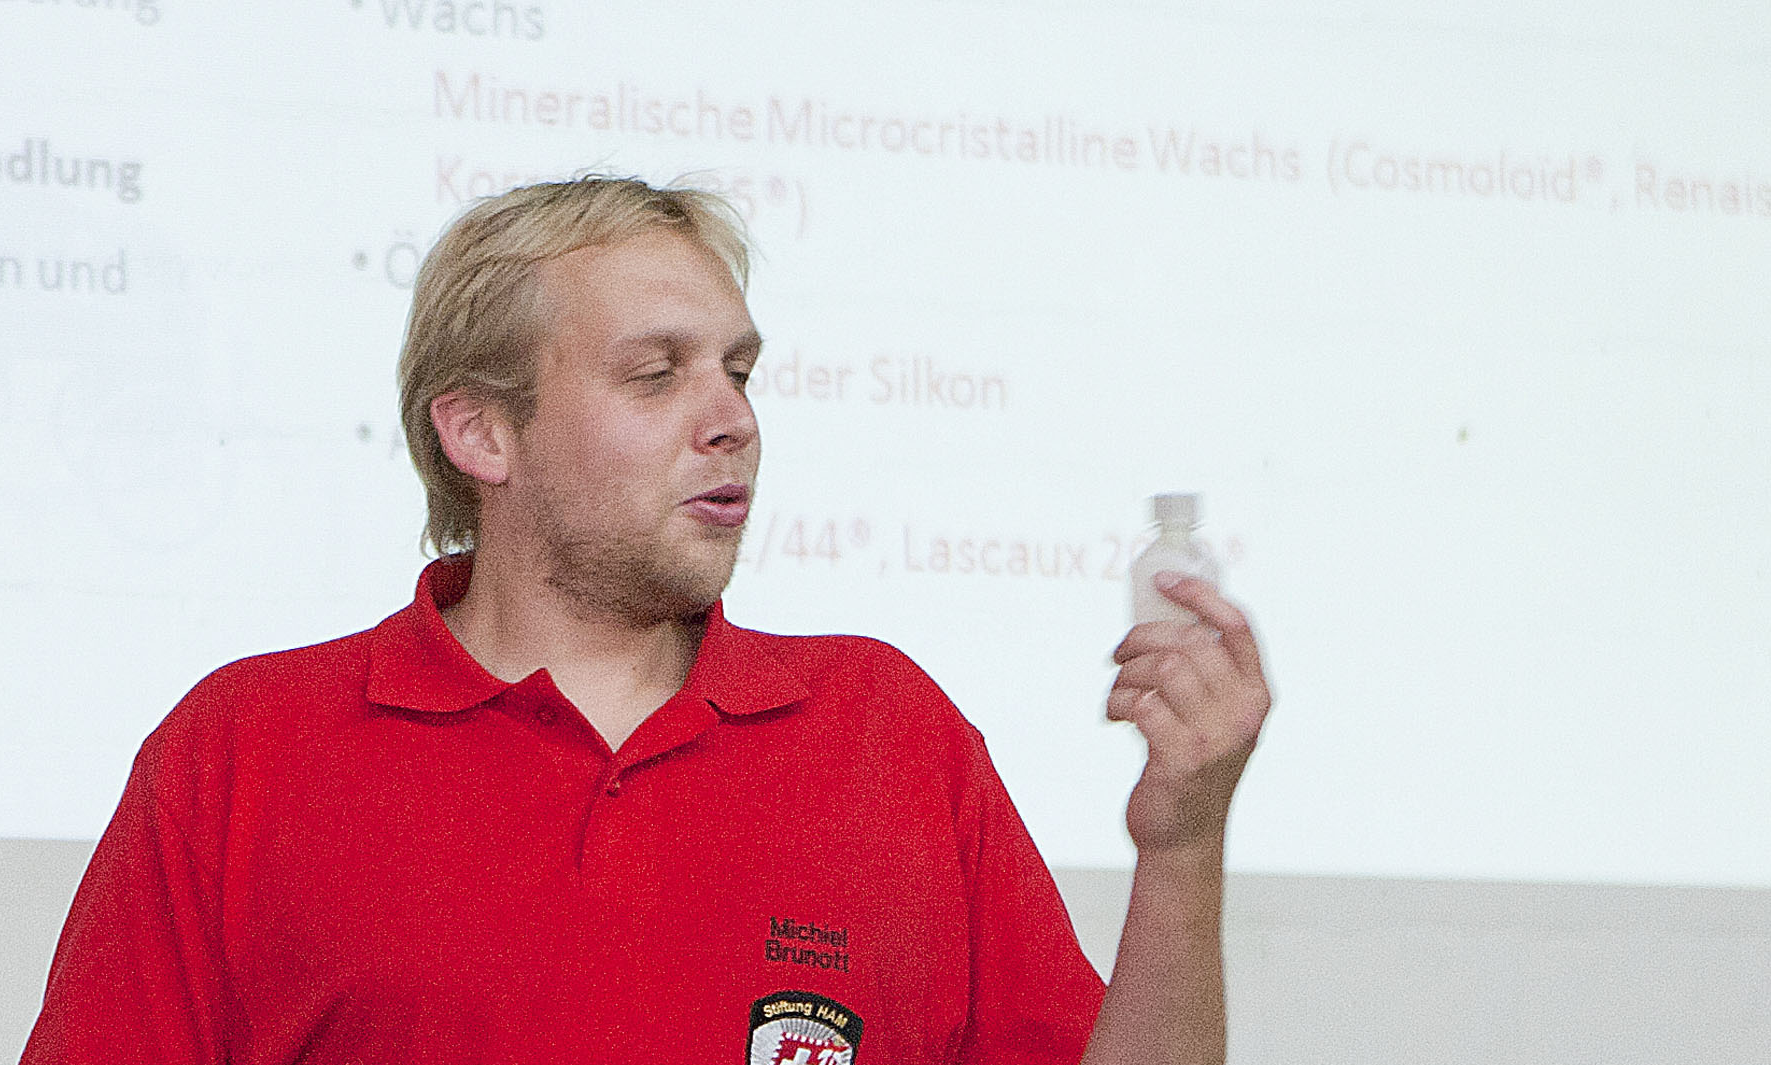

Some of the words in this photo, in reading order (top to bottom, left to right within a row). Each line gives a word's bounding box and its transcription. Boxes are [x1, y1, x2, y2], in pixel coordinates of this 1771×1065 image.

[431, 70, 754, 142] Mineralische
[766, 95, 1140, 170] Microcristalline
[1145, 123, 1302, 184] Wachs
[37, 248, 129, 295] und
[868, 356, 1011, 412] Silkon
[902, 522, 1090, 580] Lascaux
[770, 916, 848, 947] Michiel
[763, 1000, 813, 1018] Stiftung
[816, 1004, 849, 1028] HAM
